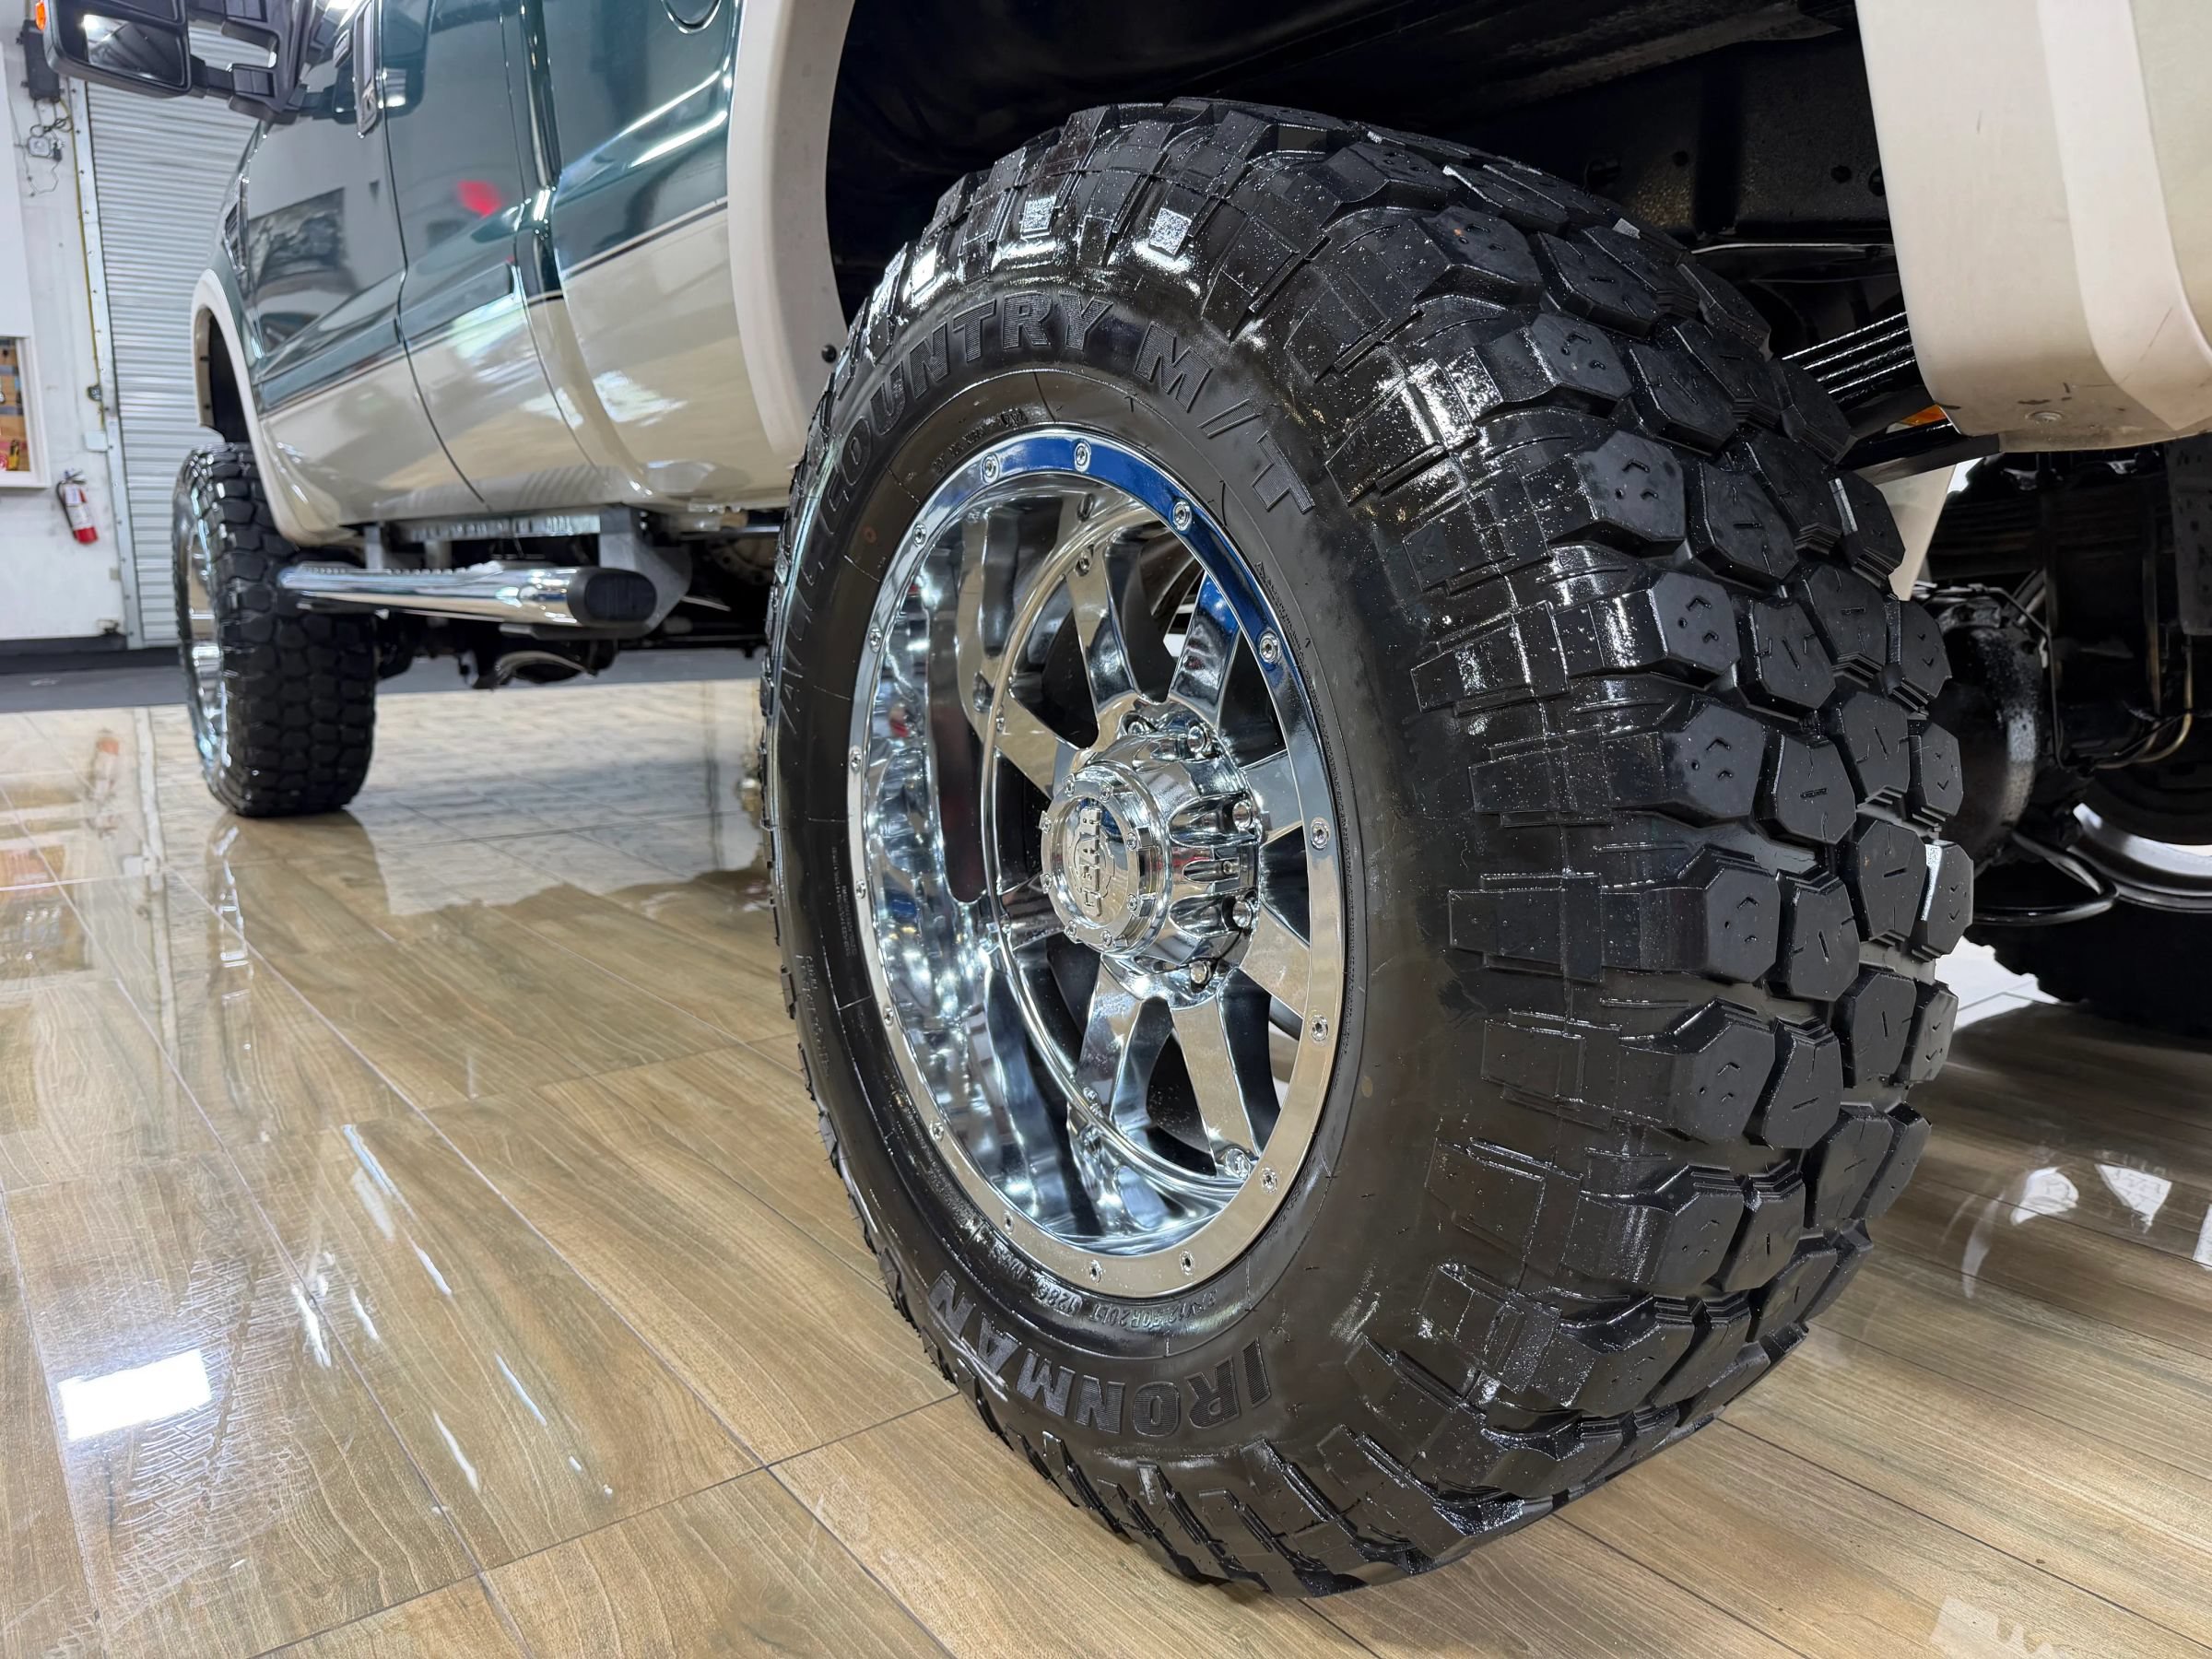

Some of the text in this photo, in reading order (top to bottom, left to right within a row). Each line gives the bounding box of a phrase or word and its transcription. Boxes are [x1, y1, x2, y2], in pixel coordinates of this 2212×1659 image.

[818, 290, 1114, 535] COUNTRY
[1135, 320, 1314, 514] M/T
[926, 1269, 1272, 1437] IRONMAN
